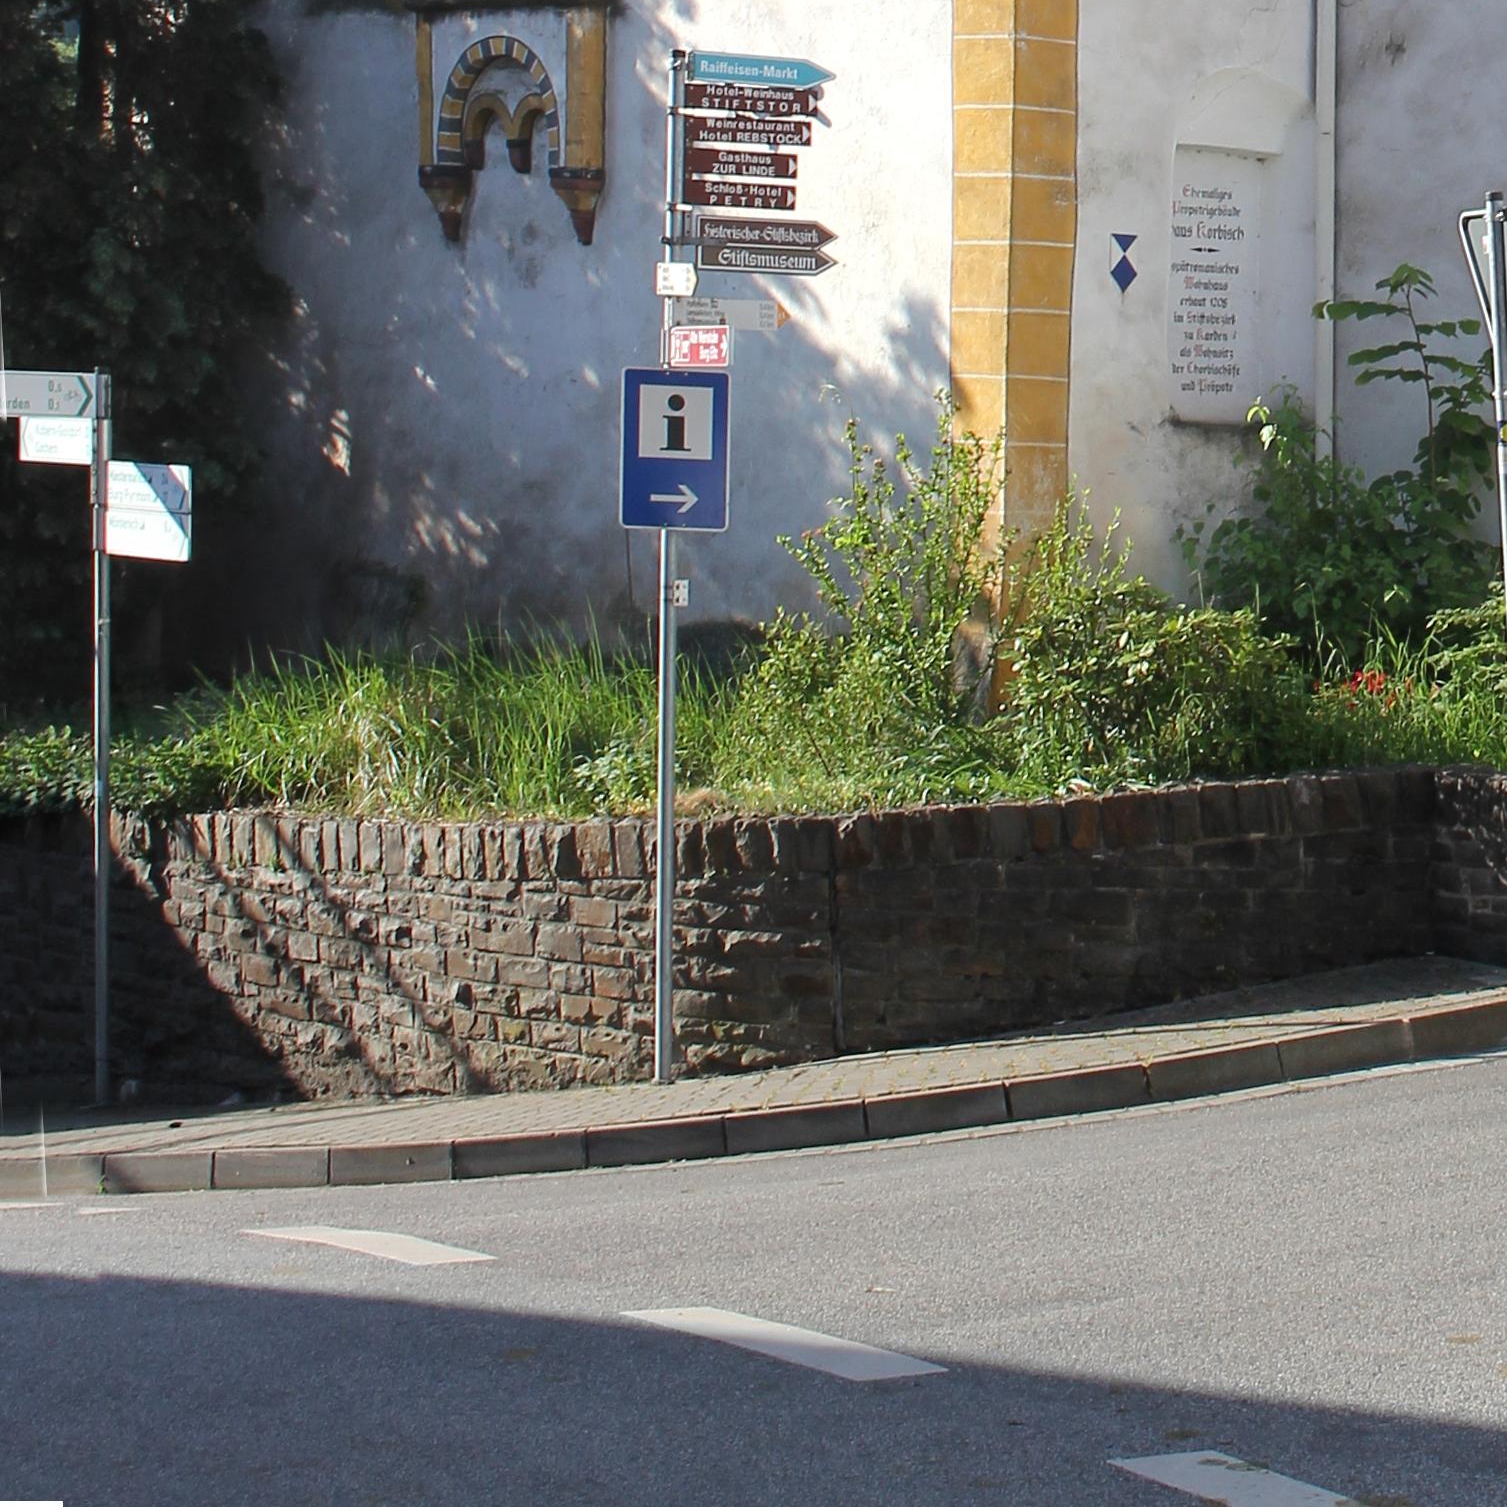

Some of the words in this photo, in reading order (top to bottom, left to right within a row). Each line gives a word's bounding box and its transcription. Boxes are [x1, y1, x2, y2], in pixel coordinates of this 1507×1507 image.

[700, 60, 798, 79] Raiffeisen-Markt
[706, 85, 794, 100] Hotel-Weinhaus
[701, 97, 801, 113] STIFTSTOR
[706, 118, 795, 132] Weinrestaurant
[699, 130, 732, 141] Hotel
[736, 132, 801, 144] REBSTOCK
[718, 151, 772, 165] Gasthaus
[711, 163, 736, 174] ZUR
[742, 165, 776, 176] LINDE
[709, 194, 778, 207] PETRY
[718, 248, 816, 269] Stiftsmuseum
